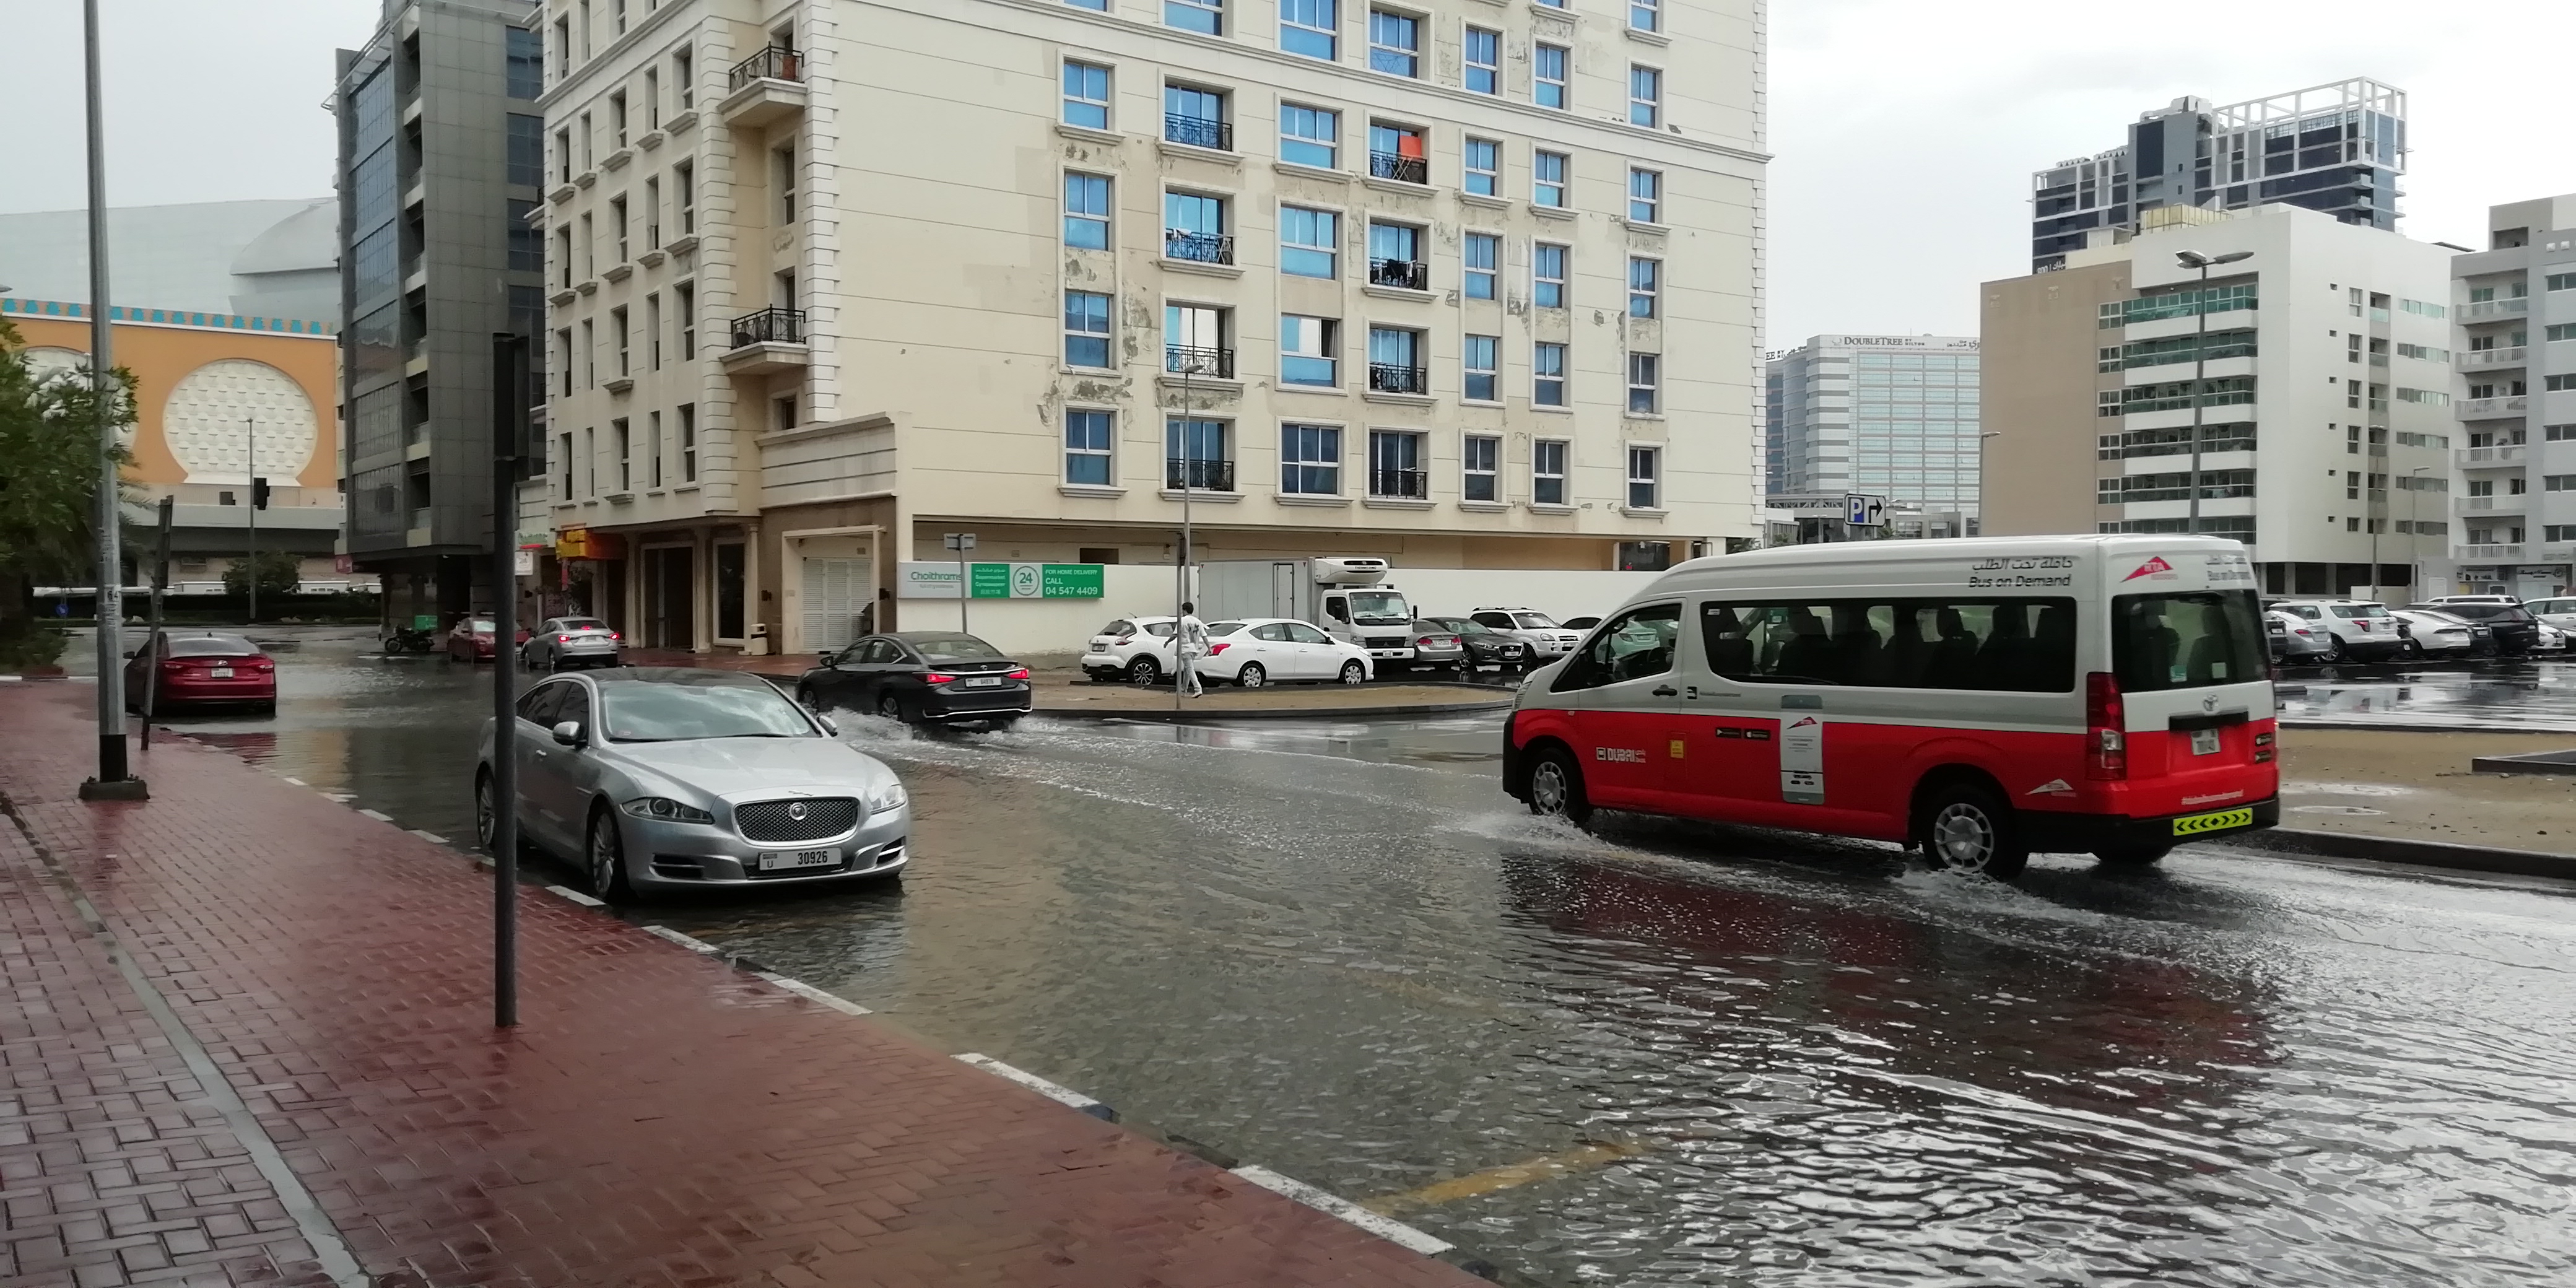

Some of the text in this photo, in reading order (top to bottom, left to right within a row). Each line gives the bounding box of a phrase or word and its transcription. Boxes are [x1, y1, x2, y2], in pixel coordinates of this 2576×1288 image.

[1850, 498, 1863, 522] P
[1972, 556, 2073, 574] حافلة تحت الطلب
[1019, 572, 1033, 584] 24
[1969, 573, 2072, 587] Bus on Demand
[1045, 587, 1098, 595] 04 547 4409
[767, 851, 828, 868] U 30926
